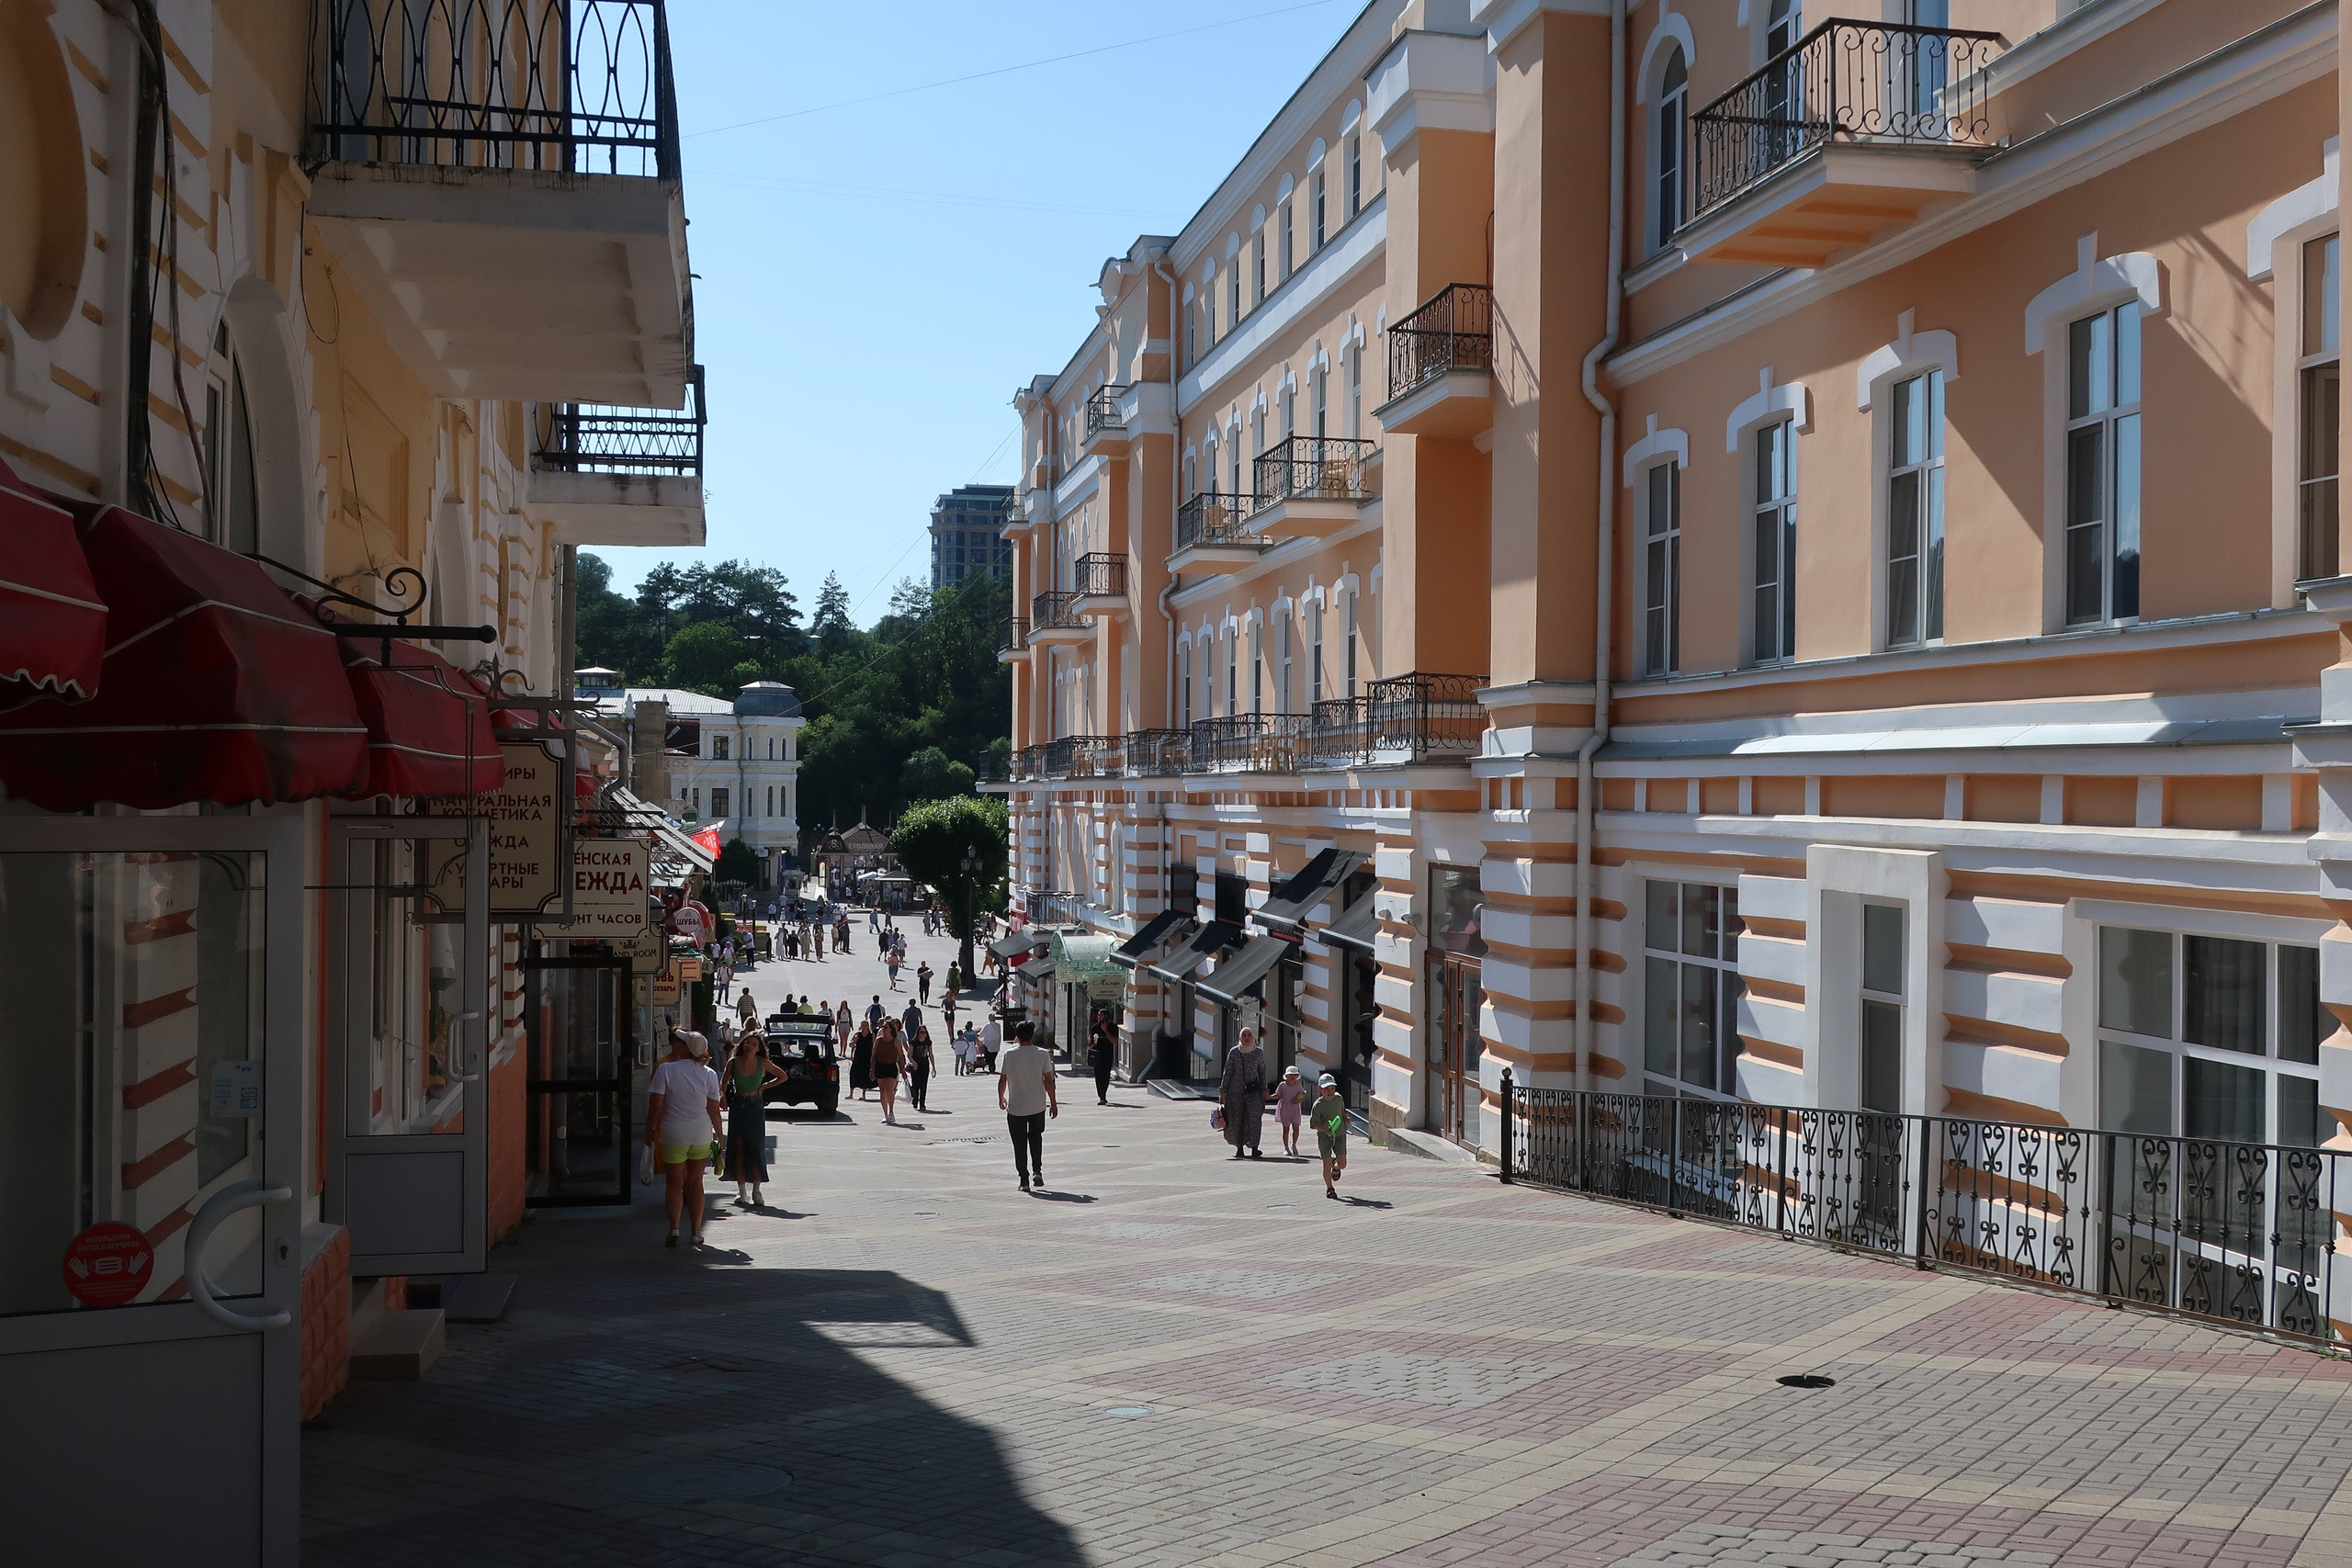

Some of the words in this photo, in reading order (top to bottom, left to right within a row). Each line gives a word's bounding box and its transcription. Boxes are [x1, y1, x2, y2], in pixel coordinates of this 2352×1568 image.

[433, 795, 551, 807] НАТРАЛЬНАЯ
[443, 808, 543, 820] КОМЕТИКА
[454, 836, 529, 850] ОЖДА
[573, 852, 631, 865] ЕНСКАЯ
[447, 863, 539, 874] УРТНЫЕ
[458, 876, 524, 888] ТАРЫ
[575, 871, 643, 895] ЕЖДА
[597, 914, 642, 924] ЧАСОВ
[676, 918, 700, 926] ШУБЫ
[633, 948, 657, 958] ROOM
[85, 1233, 130, 1244] ИСПОЛЬЗУЙТЕ
[76, 1244, 100, 1253] МАСКИ
[107, 1241, 140, 1250] ПЕРЧАТКИ
